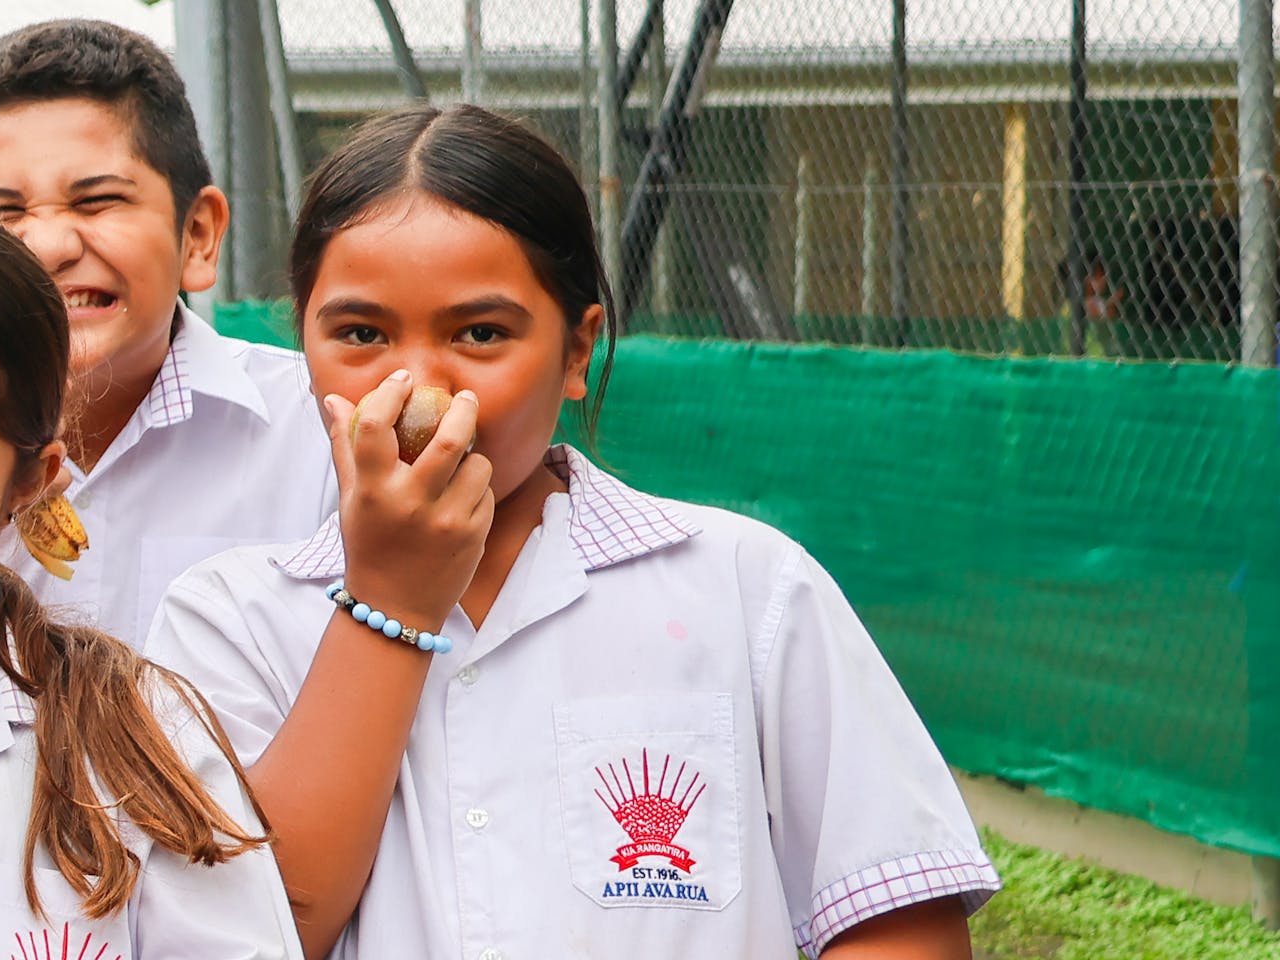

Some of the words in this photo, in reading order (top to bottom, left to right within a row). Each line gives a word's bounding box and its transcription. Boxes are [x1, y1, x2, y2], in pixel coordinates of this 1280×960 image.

[621, 846, 637, 857] KIA
[636, 843, 685, 860] RANGATIRA
[603, 881, 639, 897] APII
[642, 882, 709, 902] AVARUA
